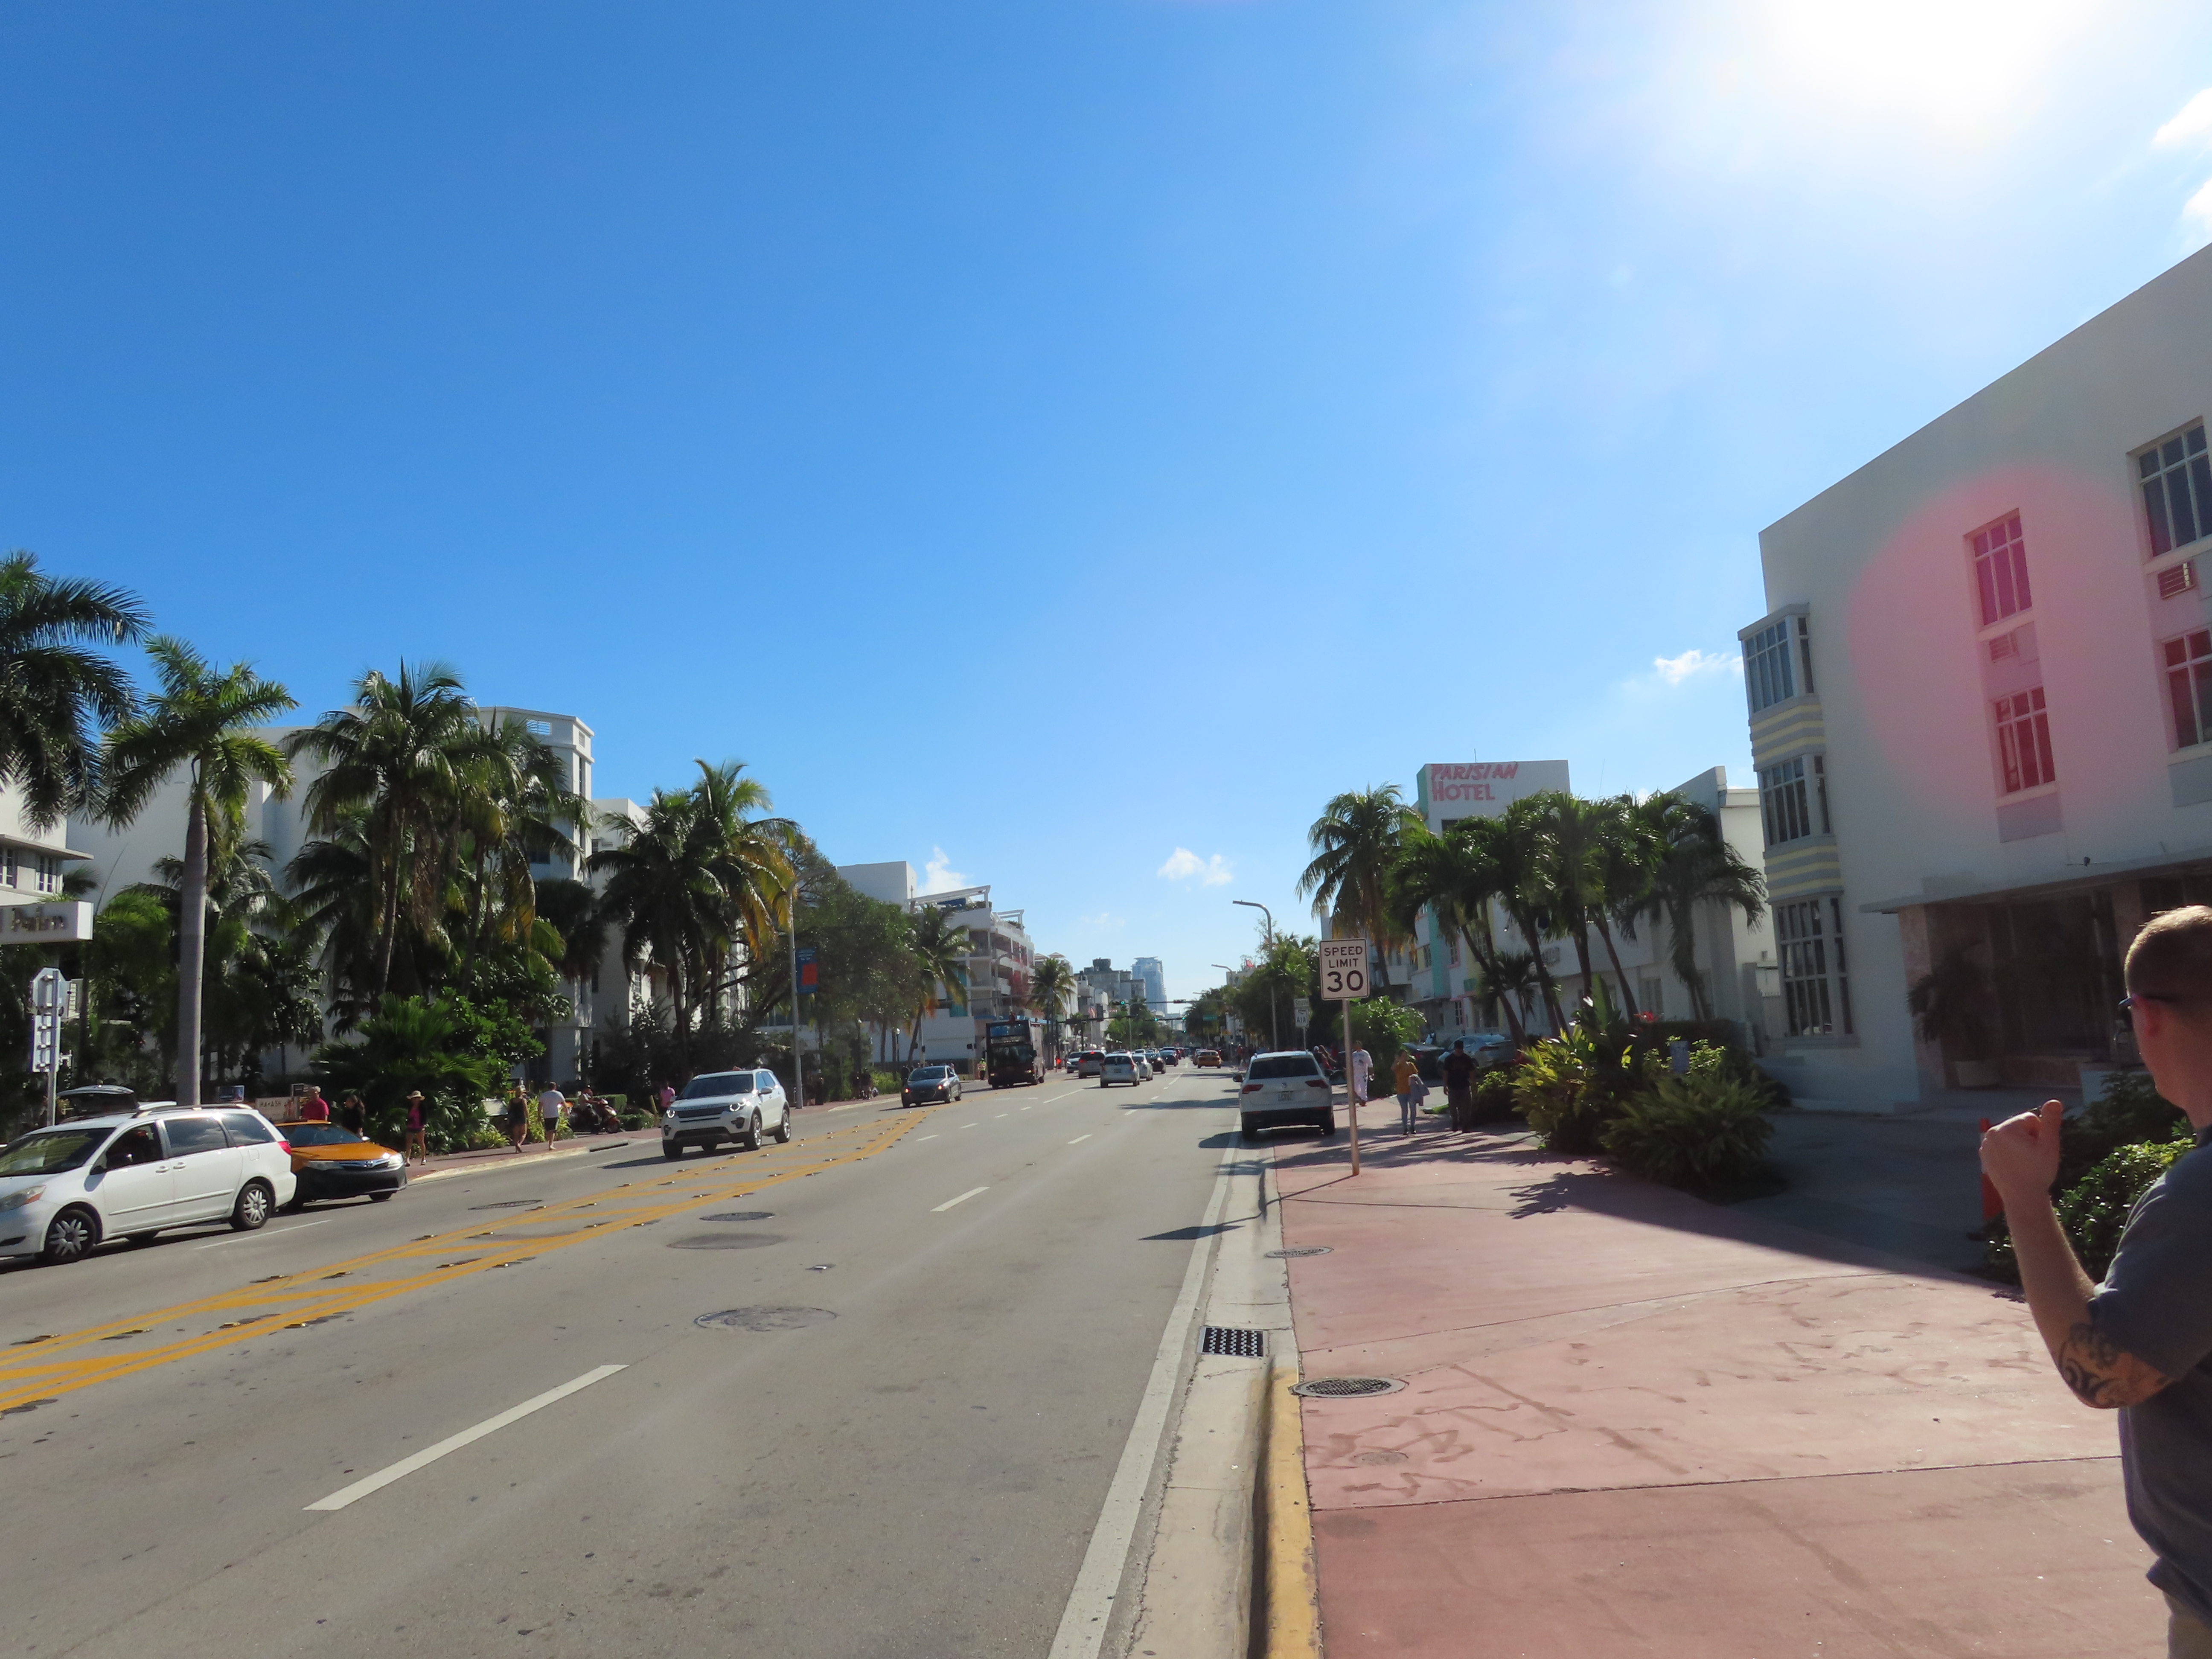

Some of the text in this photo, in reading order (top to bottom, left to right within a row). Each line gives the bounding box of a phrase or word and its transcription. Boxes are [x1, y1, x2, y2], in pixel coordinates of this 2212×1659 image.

[1431, 762, 1519, 780] PARISIAN
[1432, 780, 1495, 801] HOTEL
[1324, 946, 1363, 956] SPEED
[1329, 958, 1359, 968] LIMIT
[1327, 970, 1364, 992] 30
